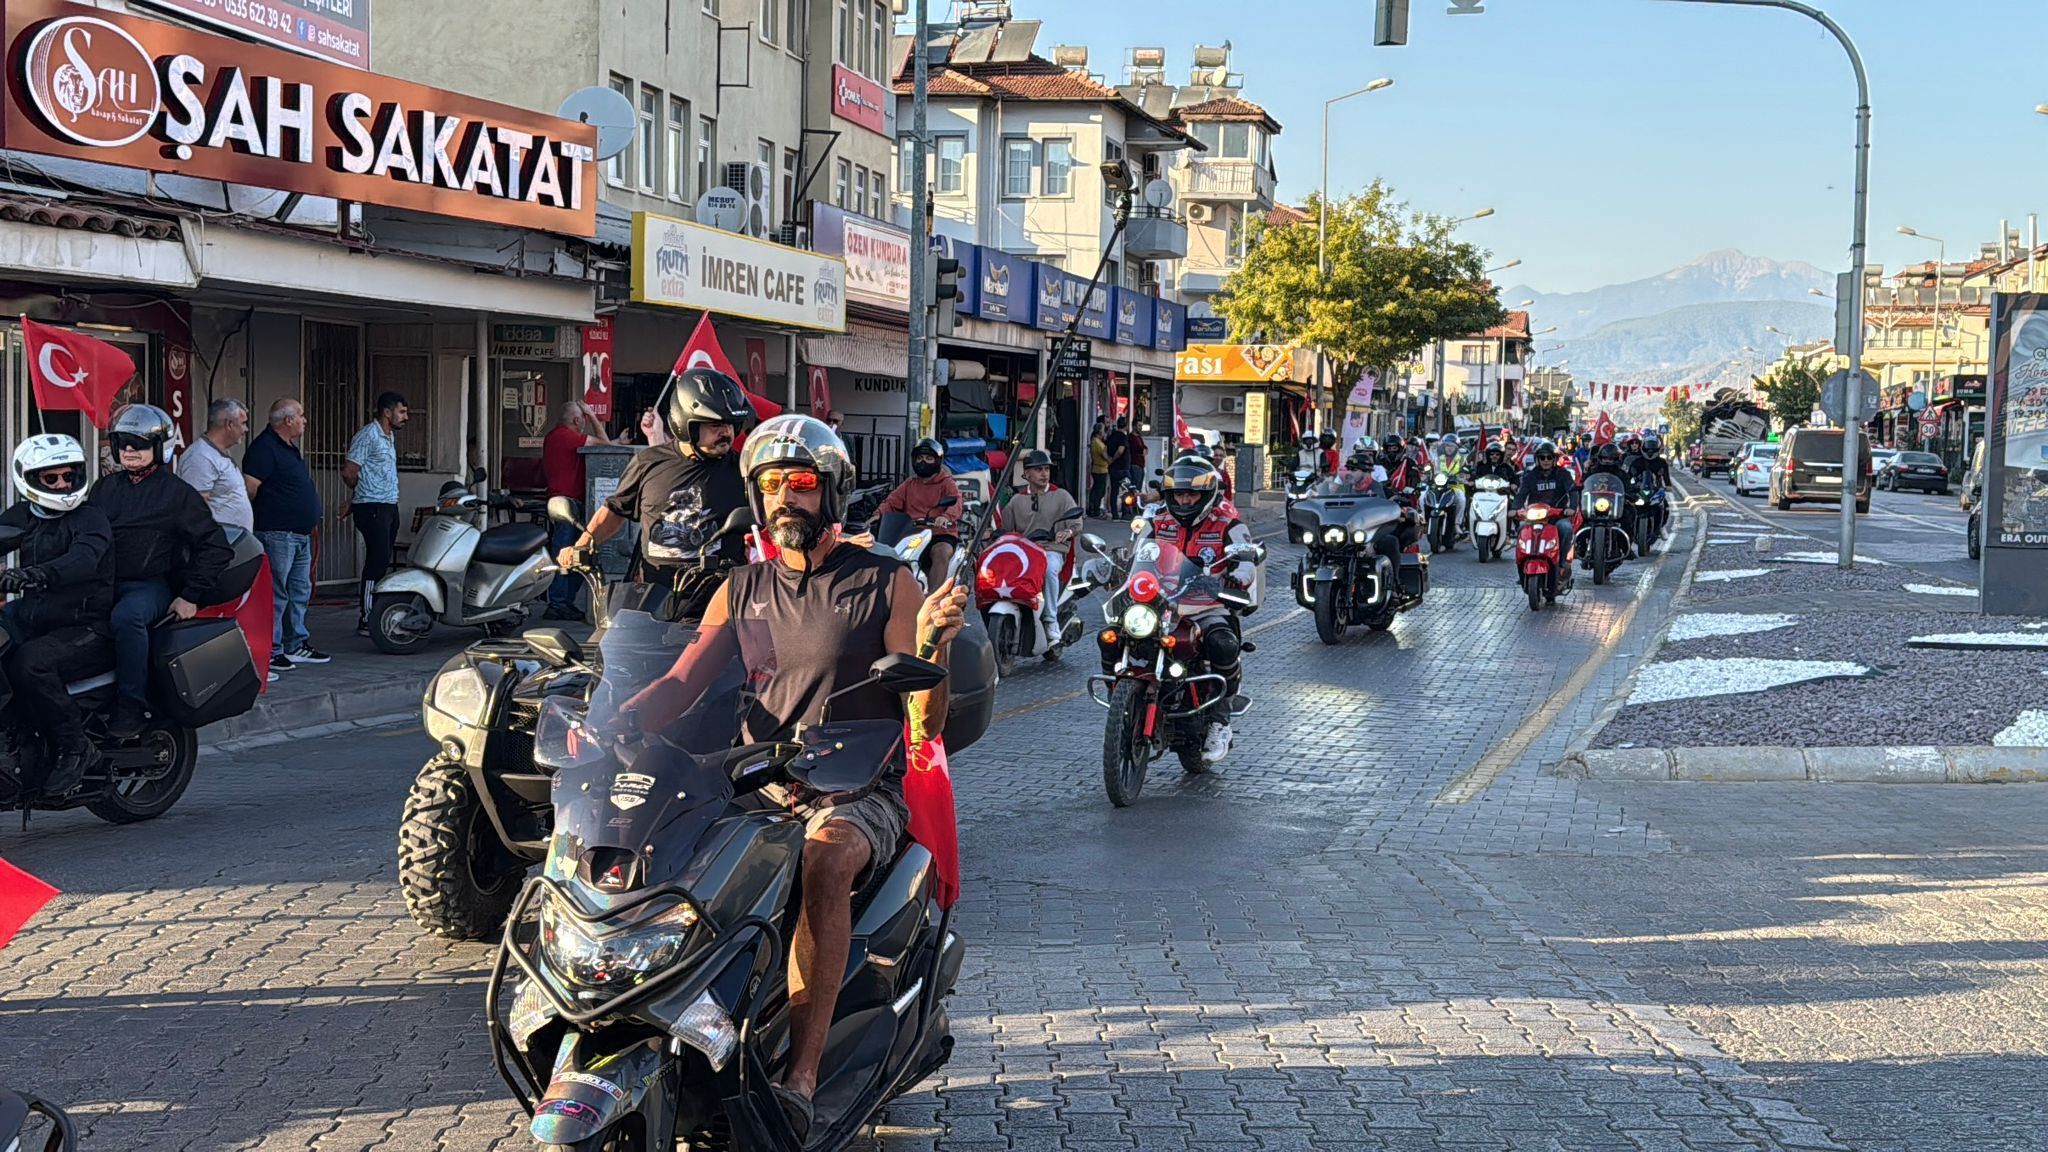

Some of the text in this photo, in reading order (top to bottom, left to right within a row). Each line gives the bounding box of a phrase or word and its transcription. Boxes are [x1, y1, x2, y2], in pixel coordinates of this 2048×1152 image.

[224, 0, 292, 34] 0535 622 39 42
[317, 29, 361, 57] sahsakatat
[166, 54, 313, 163] ŞAH
[341, 92, 593, 210] SAKATAT
[708, 195, 736, 204] MESUT
[847, 227, 908, 266] ÖZEN KUNDURA
[661, 276, 685, 298] extra
[701, 246, 805, 306] İMREN CAFE
[817, 305, 835, 324] extra
[2000, 533, 2048, 544] ERA OUT
